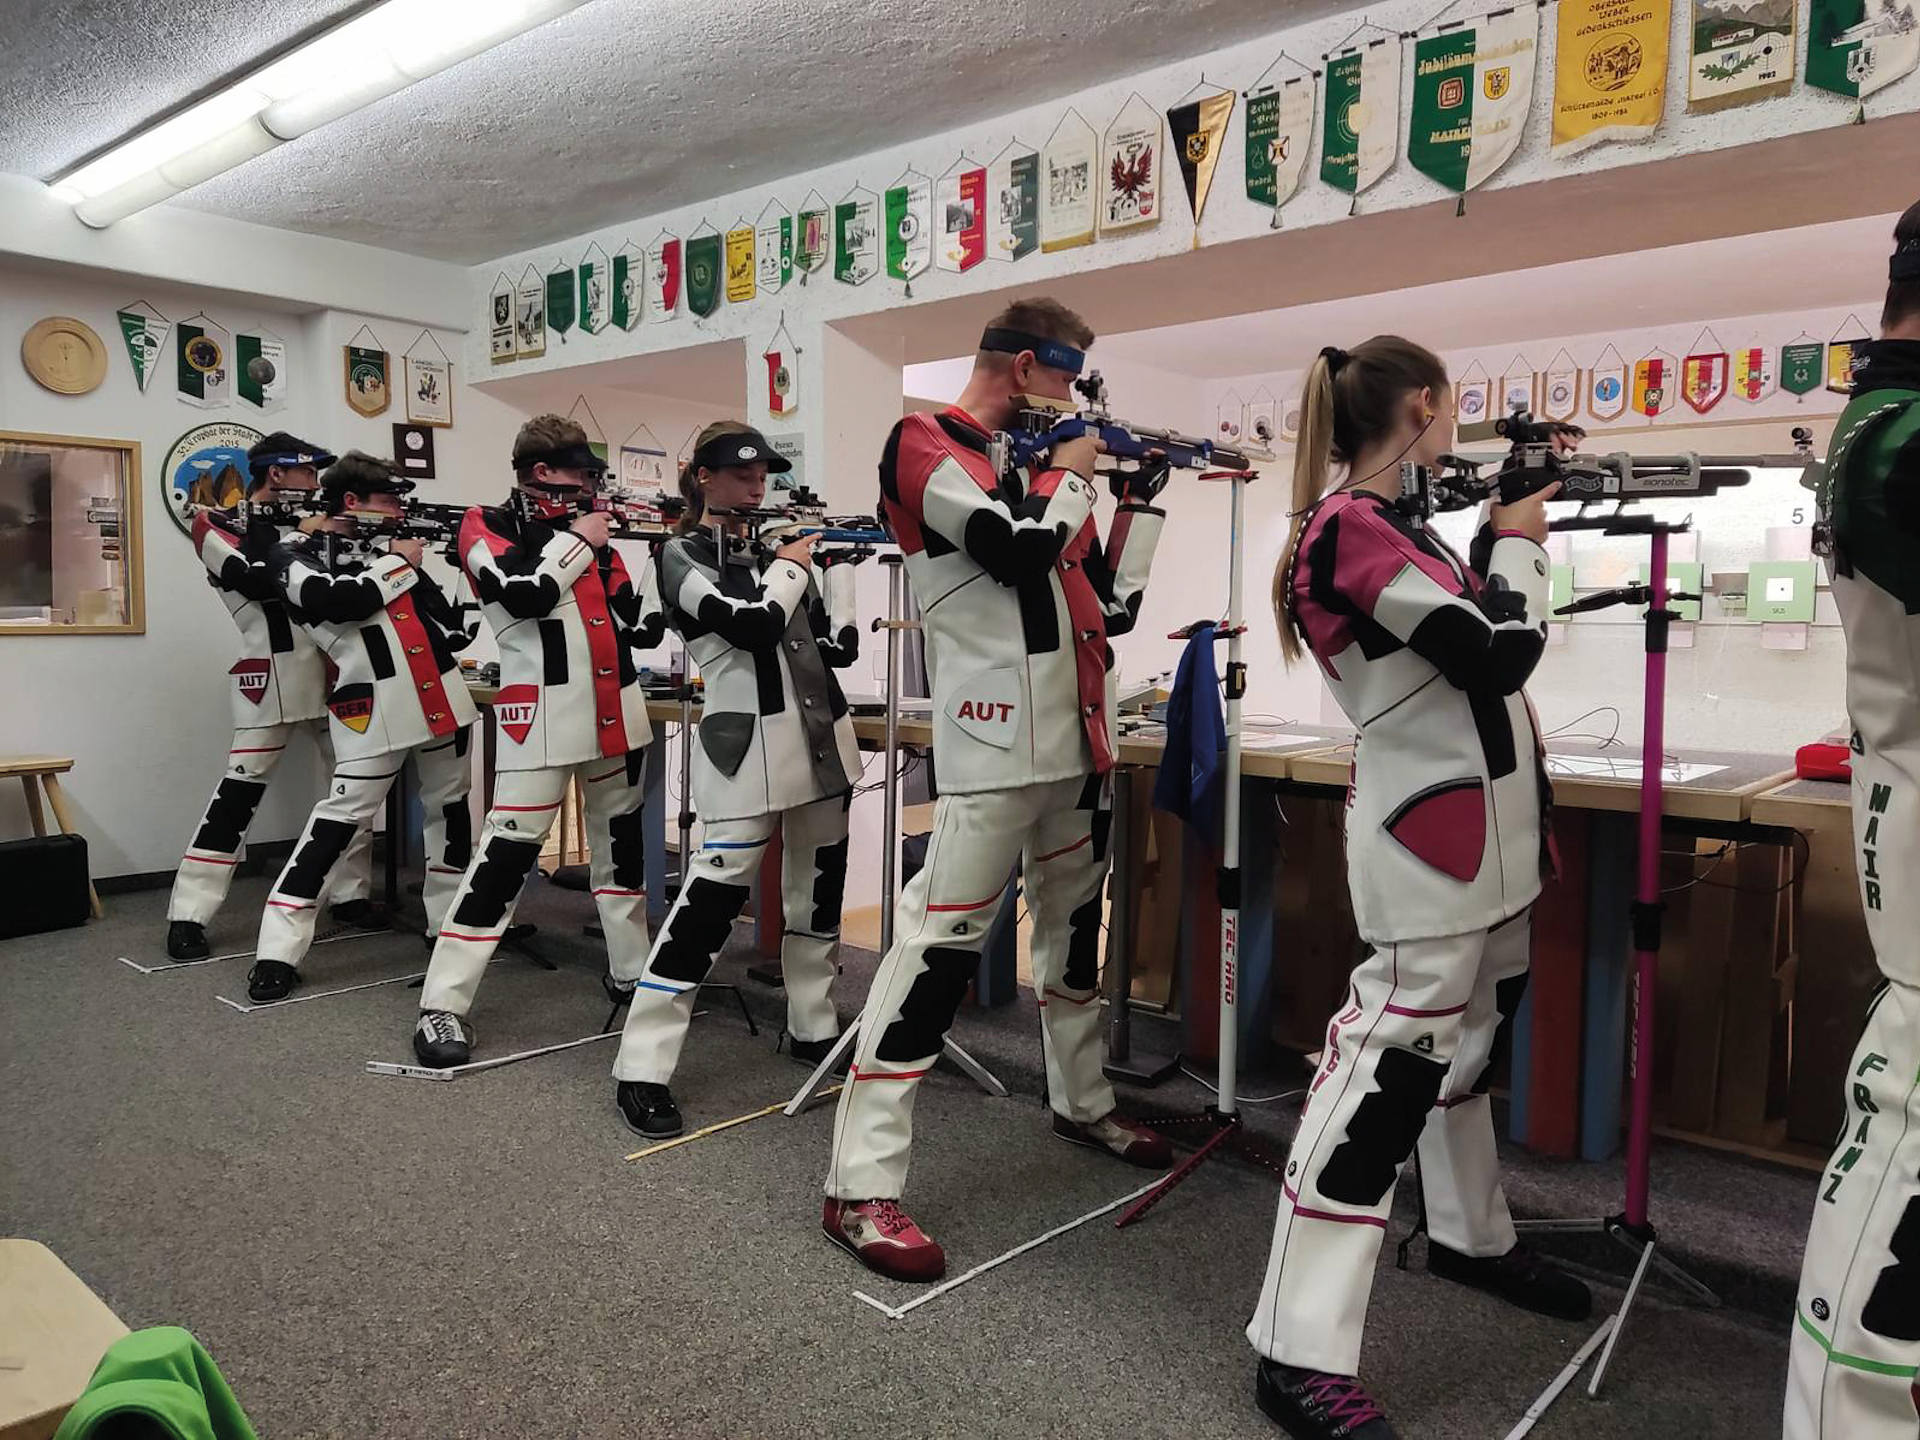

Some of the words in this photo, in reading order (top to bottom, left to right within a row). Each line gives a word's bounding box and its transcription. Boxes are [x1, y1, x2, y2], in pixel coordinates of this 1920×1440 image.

[1792, 508, 1805, 525] 5
[239, 674, 265, 688] AUT
[335, 701, 368, 718] GER
[500, 706, 532, 722] AUT
[957, 700, 1015, 723] AUT
[1864, 782, 1892, 911] MAIR
[1821, 1052, 1888, 1205] FRANZ
